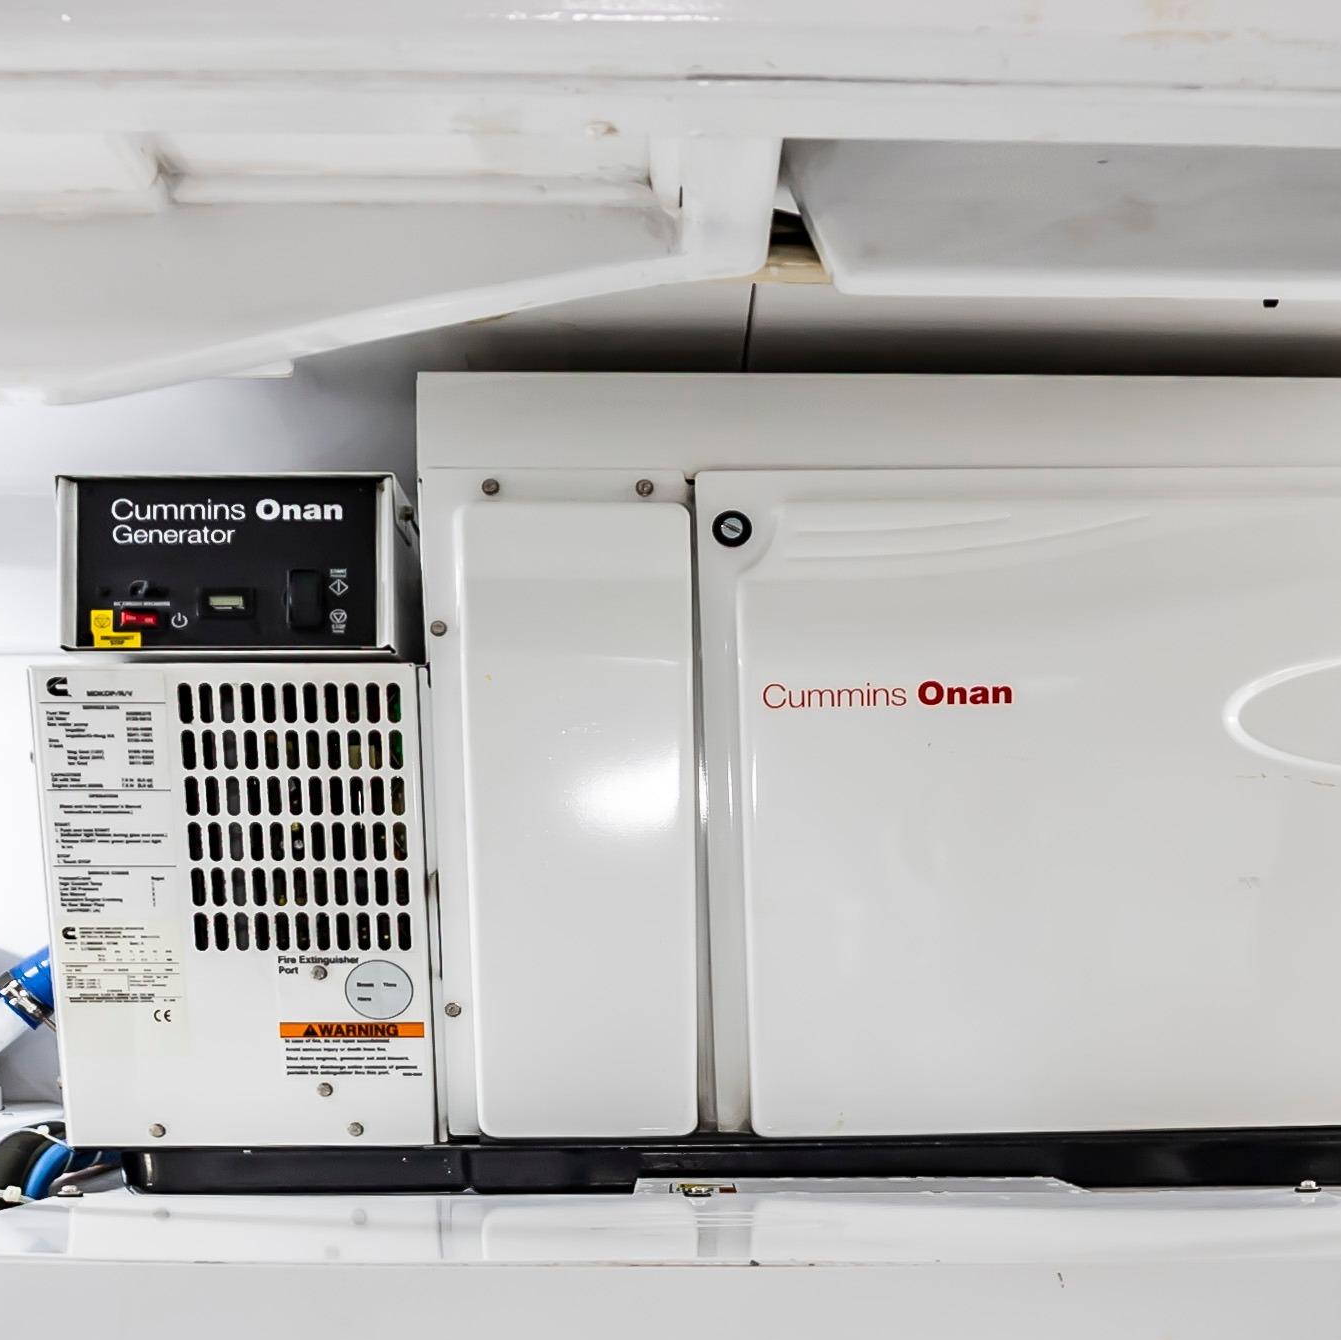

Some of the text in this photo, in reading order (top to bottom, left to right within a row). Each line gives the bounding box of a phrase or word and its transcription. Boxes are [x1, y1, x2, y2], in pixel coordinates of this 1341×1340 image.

[111, 498, 344, 521] Cummins Onan
[112, 524, 236, 545] Generator
[762, 680, 1013, 709] Cummins Onan
[277, 955, 359, 966] Fire Extinguisher
[278, 966, 299, 975] Port
[318, 1024, 399, 1038] WARNING
